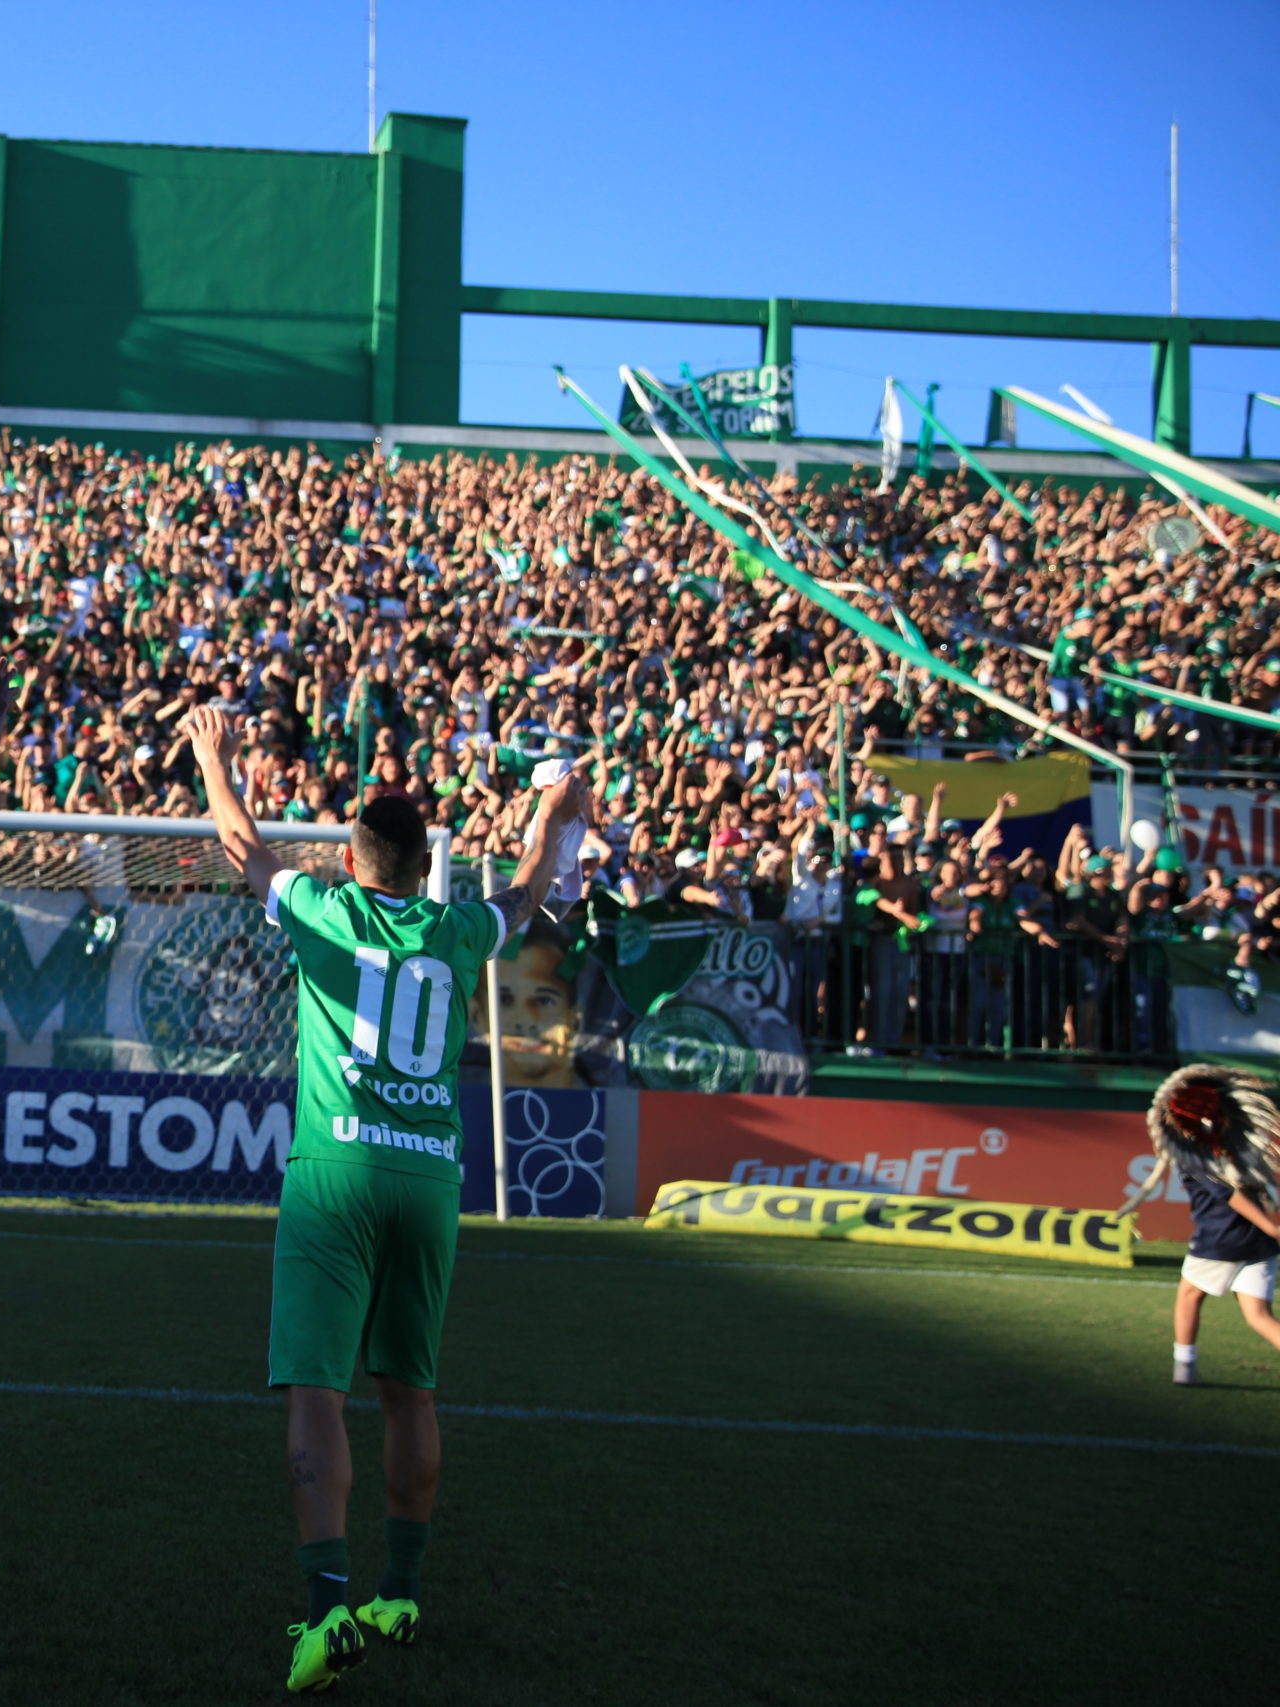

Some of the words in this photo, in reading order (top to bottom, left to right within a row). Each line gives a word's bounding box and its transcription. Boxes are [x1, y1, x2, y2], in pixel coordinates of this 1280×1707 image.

[350, 946, 453, 1078] 10
[367, 1079, 452, 1106] ICOOB
[332, 1115, 457, 1162] Unimed
[656, 1185, 1123, 1253] quartzolit
